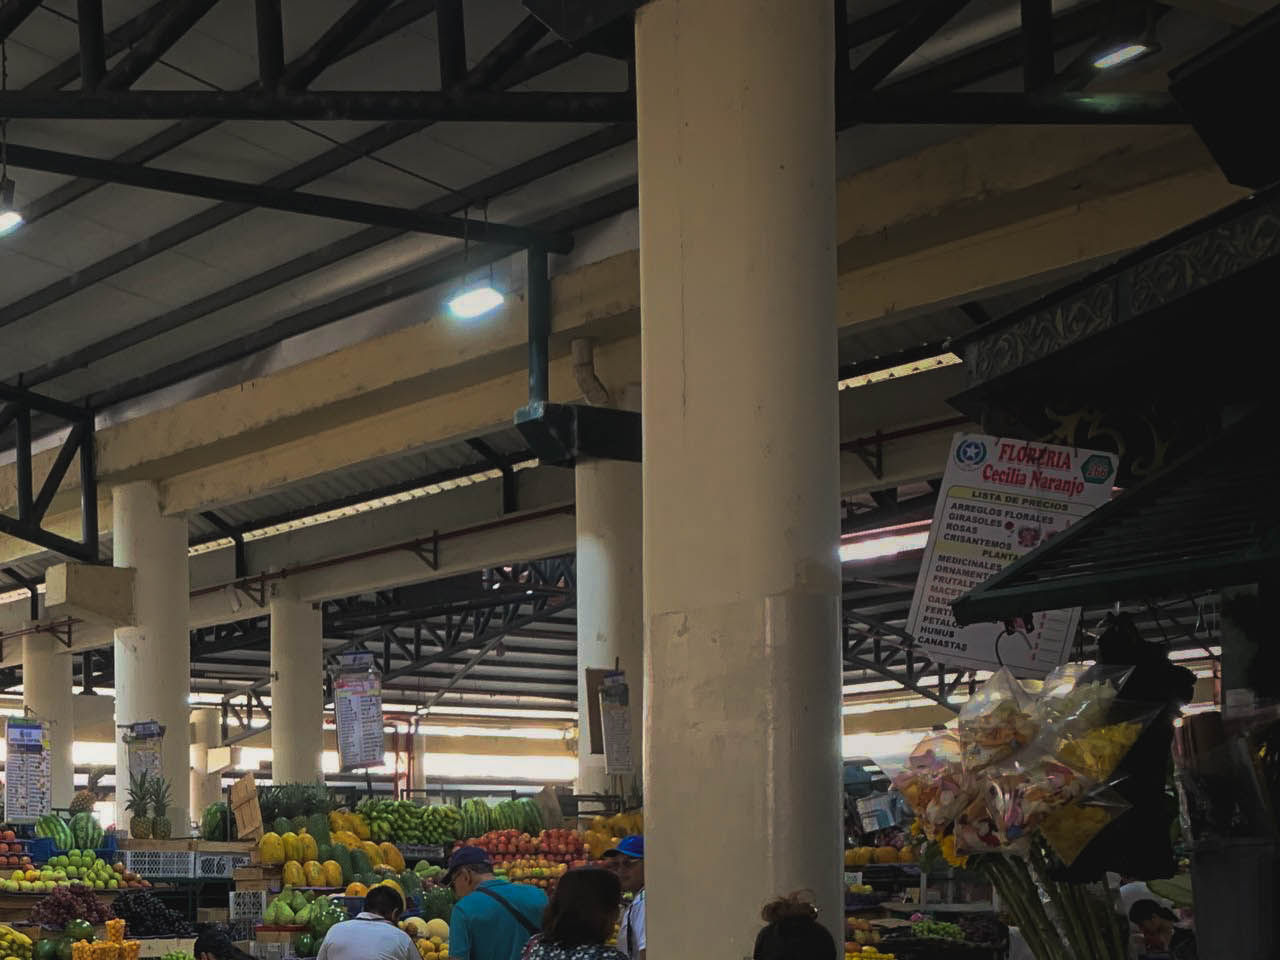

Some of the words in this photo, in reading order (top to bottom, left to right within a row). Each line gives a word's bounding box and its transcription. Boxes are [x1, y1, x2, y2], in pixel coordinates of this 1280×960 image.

[982, 464, 1026, 487] Cecilia
[1029, 470, 1085, 497] Naranjo
[972, 491, 1001, 503] LISTA
[1005, 495, 1018, 505] DE
[1021, 497, 1069, 511] PRECIOS
[948, 513, 1002, 528] GIRASOLES
[950, 502, 1002, 517] ARREGLOS
[1004, 510, 1054, 525] FLORALES
[946, 523, 978, 535] ROSAS
[943, 533, 1012, 551] CRISANTEMOS
[937, 554, 1002, 572] MEDICINALES
[935, 565, 993, 581] ORNAMENT
[932, 575, 976, 588] FRUTALE
[930, 585, 963, 597] MACET
[925, 606, 953, 617] FERTI
[920, 626, 955, 638] HUMUS
[917, 636, 968, 651] CANASTAS
